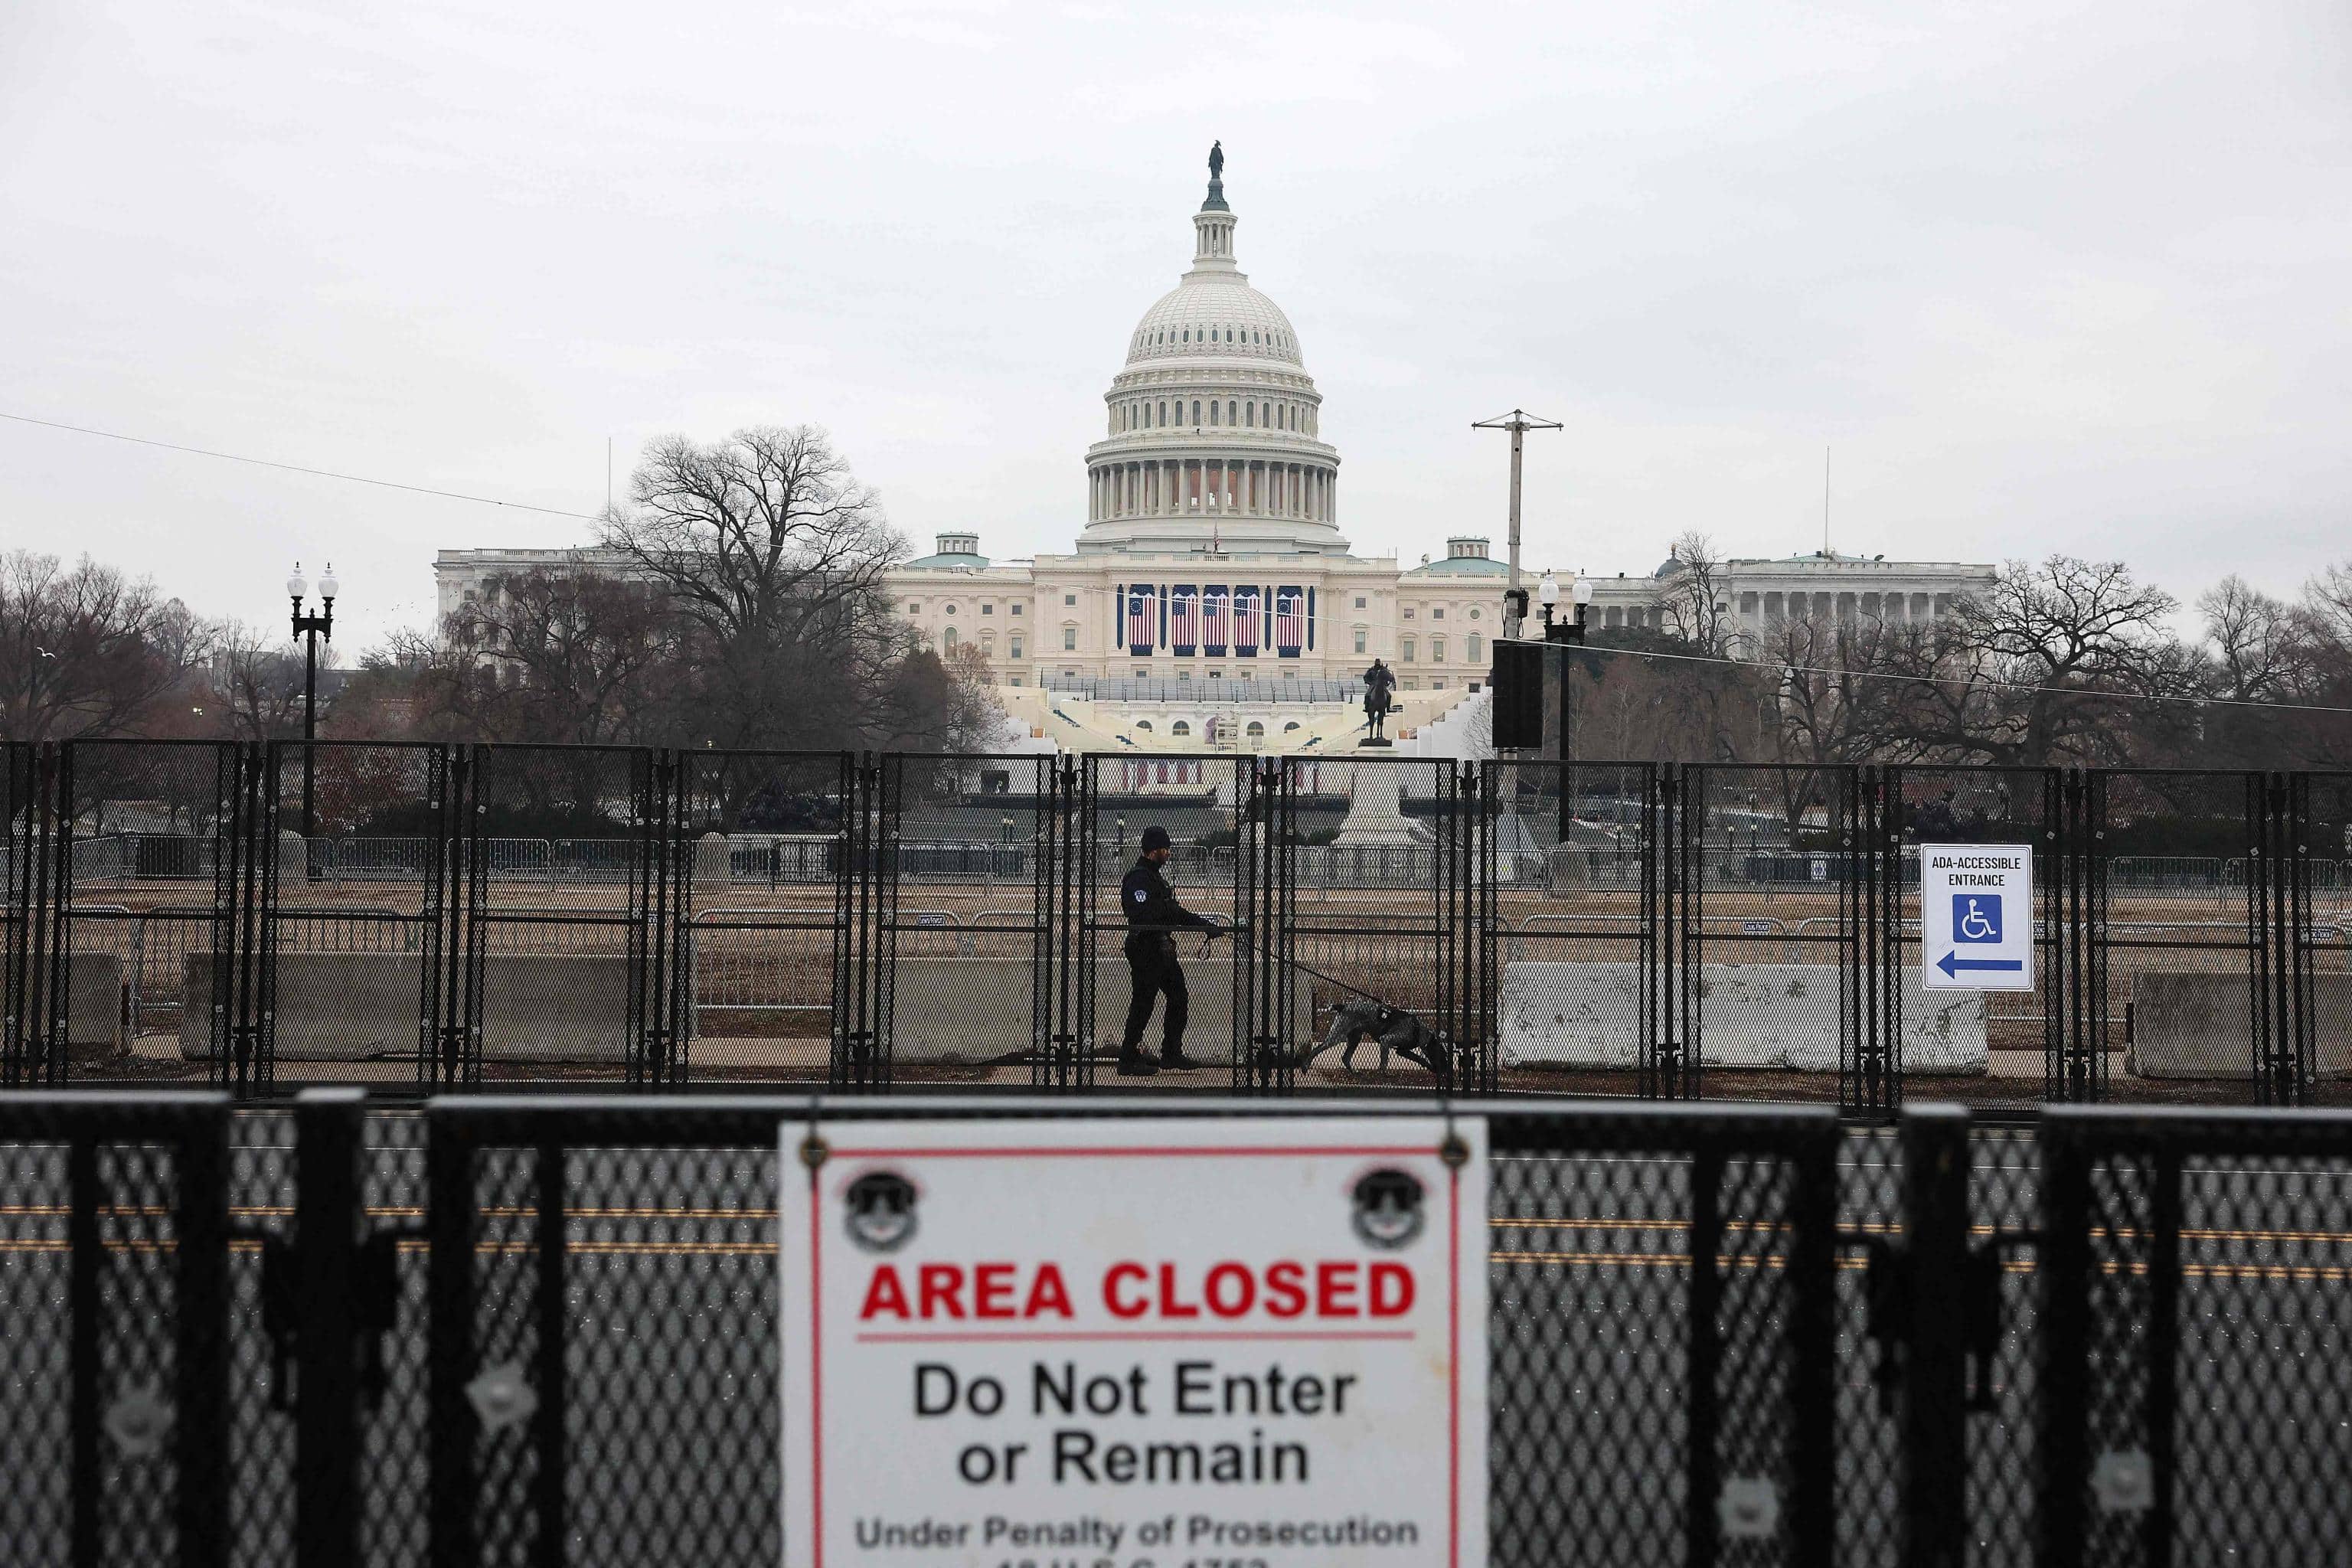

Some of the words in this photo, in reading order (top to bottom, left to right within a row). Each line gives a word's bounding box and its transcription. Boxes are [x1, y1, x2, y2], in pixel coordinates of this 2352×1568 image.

[1932, 857, 2020, 869] ADA-ACCESSIBLE
[1949, 874, 2004, 887] ENTRANCE
[859, 1262, 1075, 1321] AREA
[1102, 1260, 1416, 1321] CLOSED
[913, 1363, 1004, 1417] Do
[1033, 1362, 1148, 1417] Not
[1174, 1361, 1357, 1417] Enter
[958, 1444, 1027, 1485] or
[1053, 1429, 1308, 1485] Remain
[855, 1518, 970, 1550] Under
[984, 1516, 1125, 1555] Penalty
[1138, 1514, 1176, 1547] of
[1187, 1514, 1418, 1547] Prosecution
